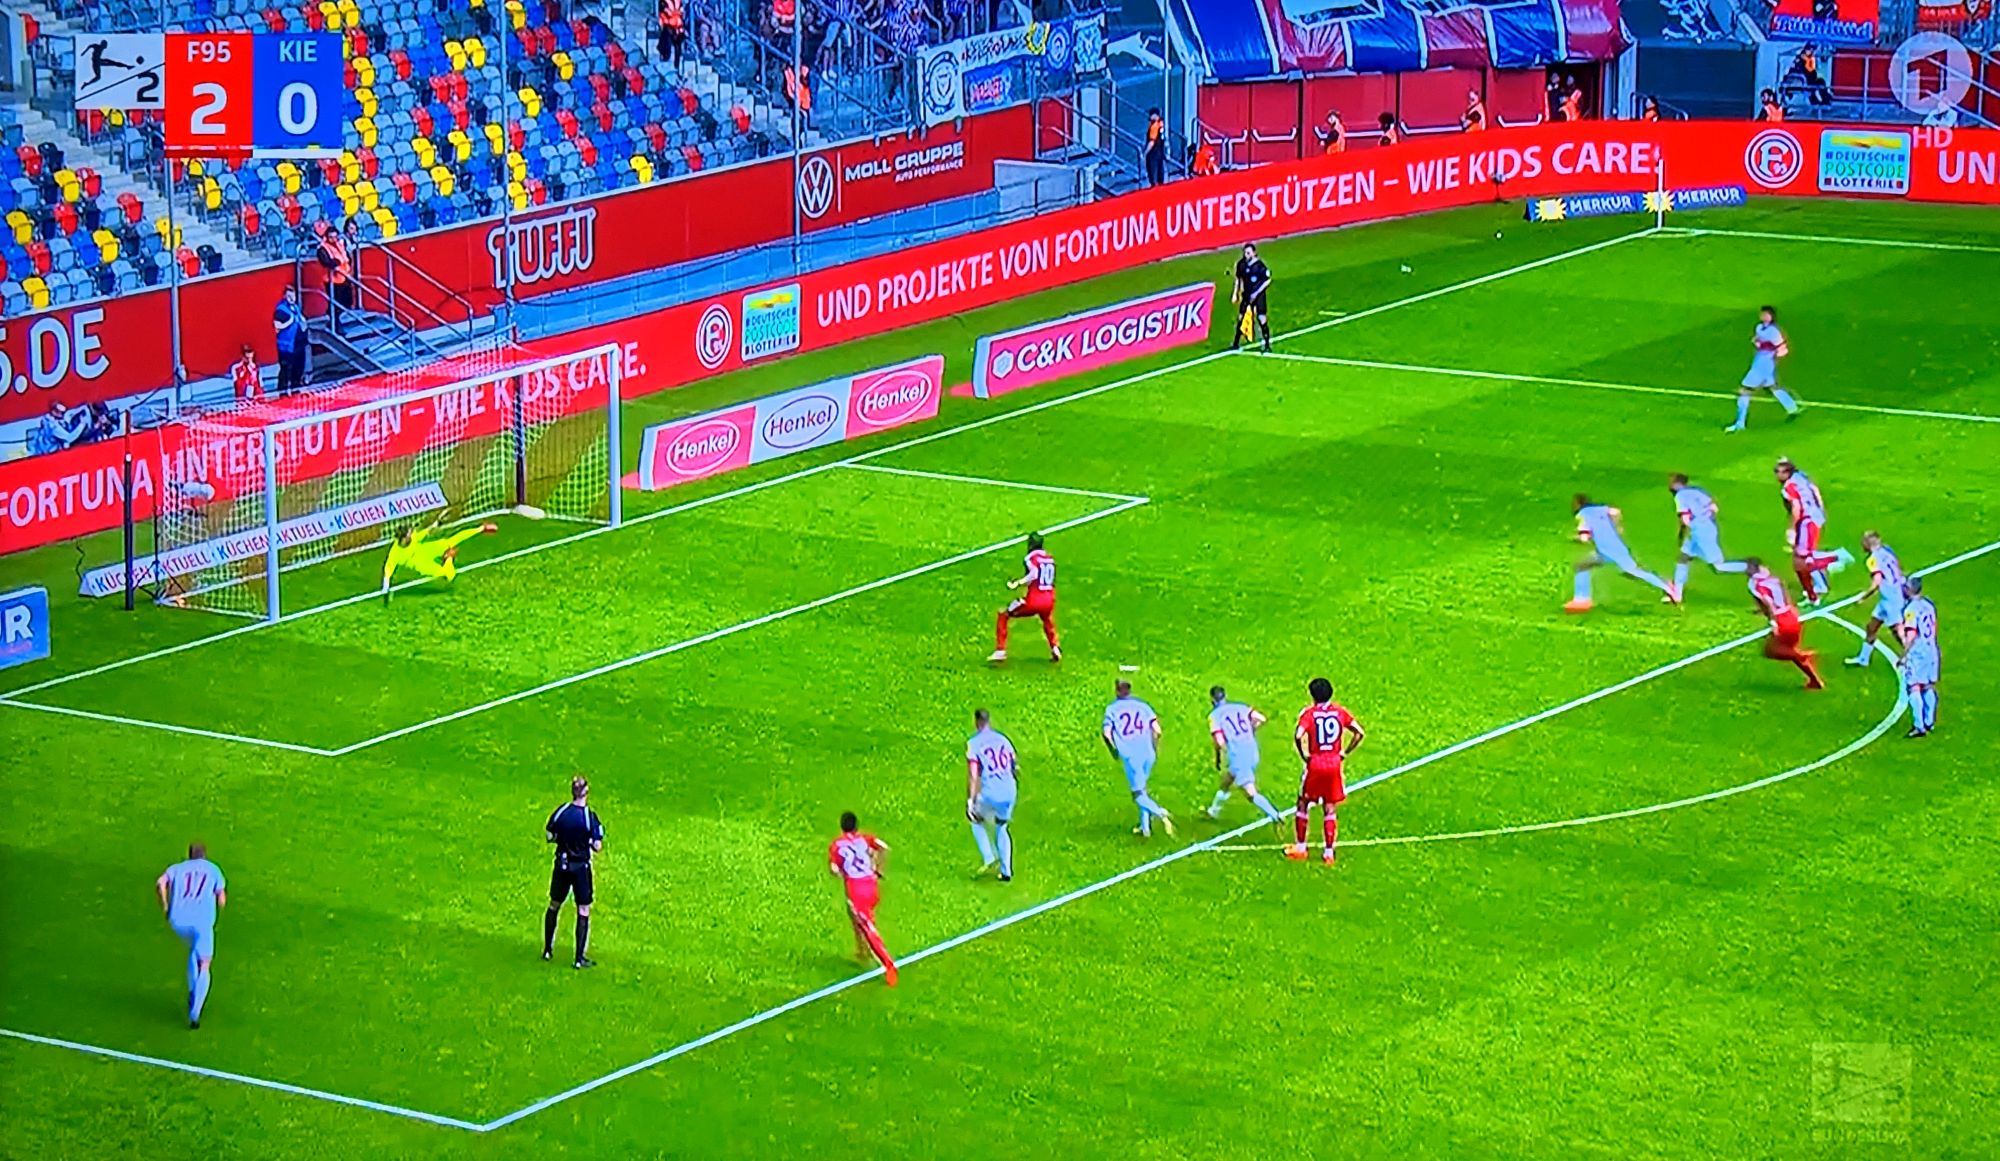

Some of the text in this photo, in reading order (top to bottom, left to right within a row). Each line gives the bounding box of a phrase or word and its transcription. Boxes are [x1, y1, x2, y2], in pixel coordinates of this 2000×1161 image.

[844, 141, 963, 182] MOLL GRUPPE
[1825, 161, 1905, 178] POSTCODE
[1938, 150, 2000, 185] UN
[1569, 195, 1632, 213] MERKUR
[1678, 187, 1741, 204] MERKUR
[817, 283, 871, 328] UND
[878, 251, 993, 313] PROJEKTE
[999, 237, 1049, 281] VON
[1054, 208, 1160, 268] FORTUNA
[1166, 168, 1375, 238] UNTERSTÜTZEN
[1407, 155, 1460, 195] WIE
[1468, 145, 1542, 181] KIDS
[1016, 298, 1205, 373] C&K LOGISTIK
[432, 385, 486, 424] WIE
[494, 368, 560, 411] KDS
[863, 380, 926, 415] Henkel
[768, 404, 833, 438] Henkel
[671, 429, 733, 463] Henkel
[95, 562, 153, 593] KÜCEN
[334, 504, 388, 530] KÜCHEN
[388, 490, 441, 516] AKTUELL
[1039, 562, 1056, 586] 10
[0, 604, 34, 644] R
[1119, 711, 1145, 737] 24
[1225, 711, 1249, 736] 16
[1315, 717, 1341, 745] 19
[983, 744, 1009, 772] 36
